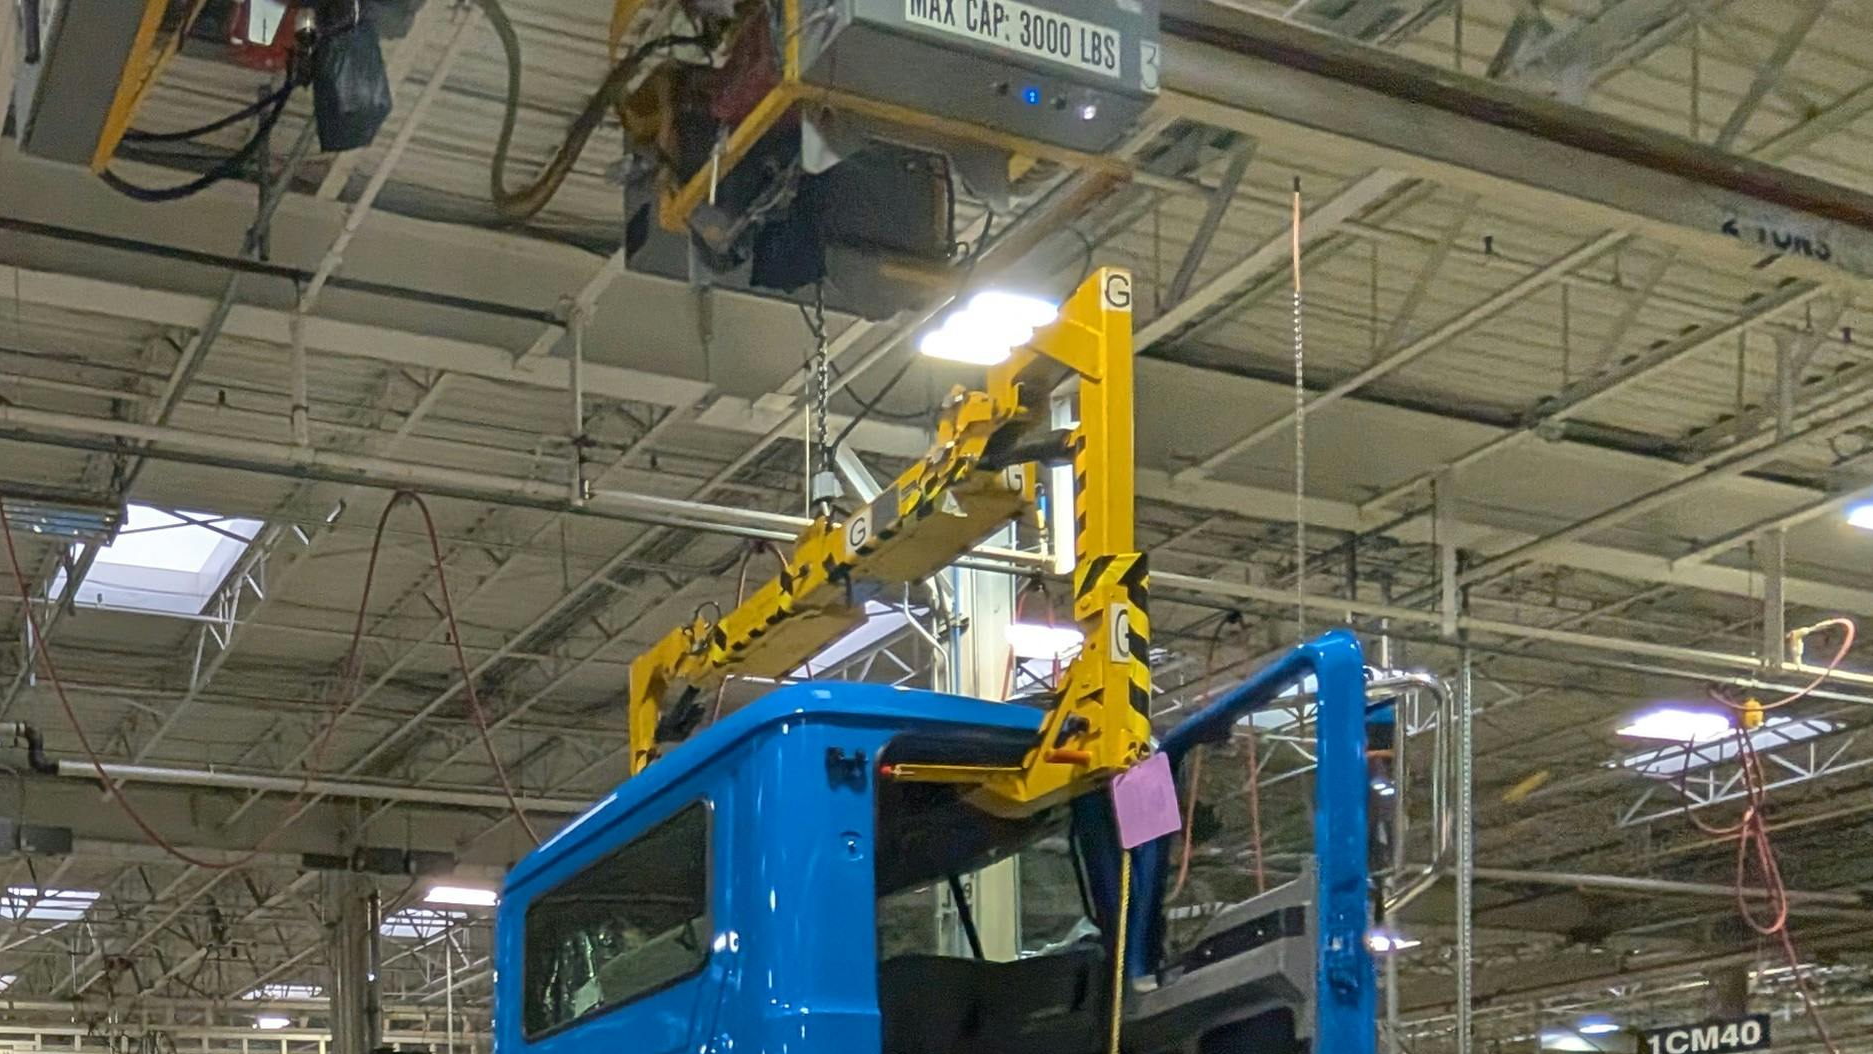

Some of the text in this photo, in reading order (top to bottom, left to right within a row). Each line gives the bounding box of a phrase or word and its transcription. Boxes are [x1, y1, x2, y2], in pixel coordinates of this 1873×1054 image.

[1020, 11, 1071, 57] 3000
[1081, 28, 1116, 69] LBS
[1105, 274, 1130, 308] G
[849, 516, 866, 547] G
